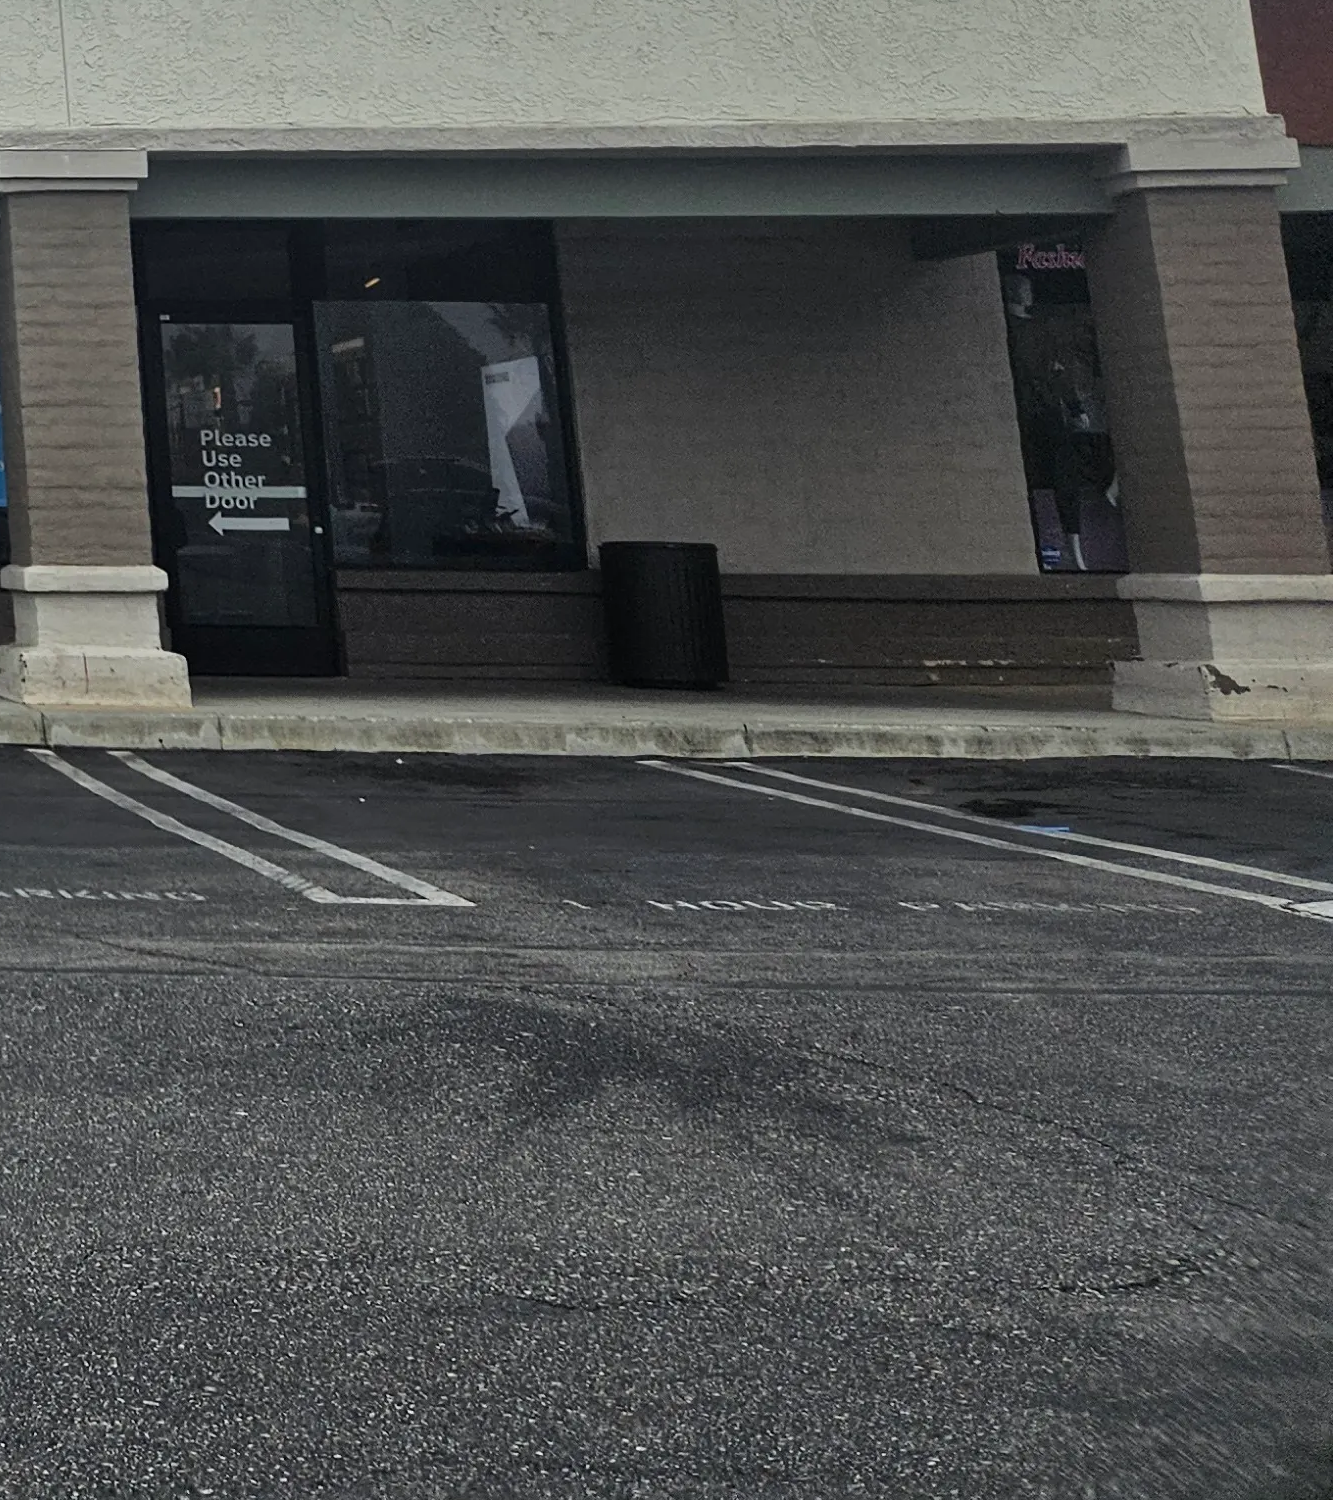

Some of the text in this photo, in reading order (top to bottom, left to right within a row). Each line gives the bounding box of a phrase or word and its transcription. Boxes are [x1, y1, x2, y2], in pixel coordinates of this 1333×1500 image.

[200, 429, 272, 447] Please
[201, 450, 242, 467] Use
[204, 470, 266, 489] Other
[205, 492, 258, 509] Door
